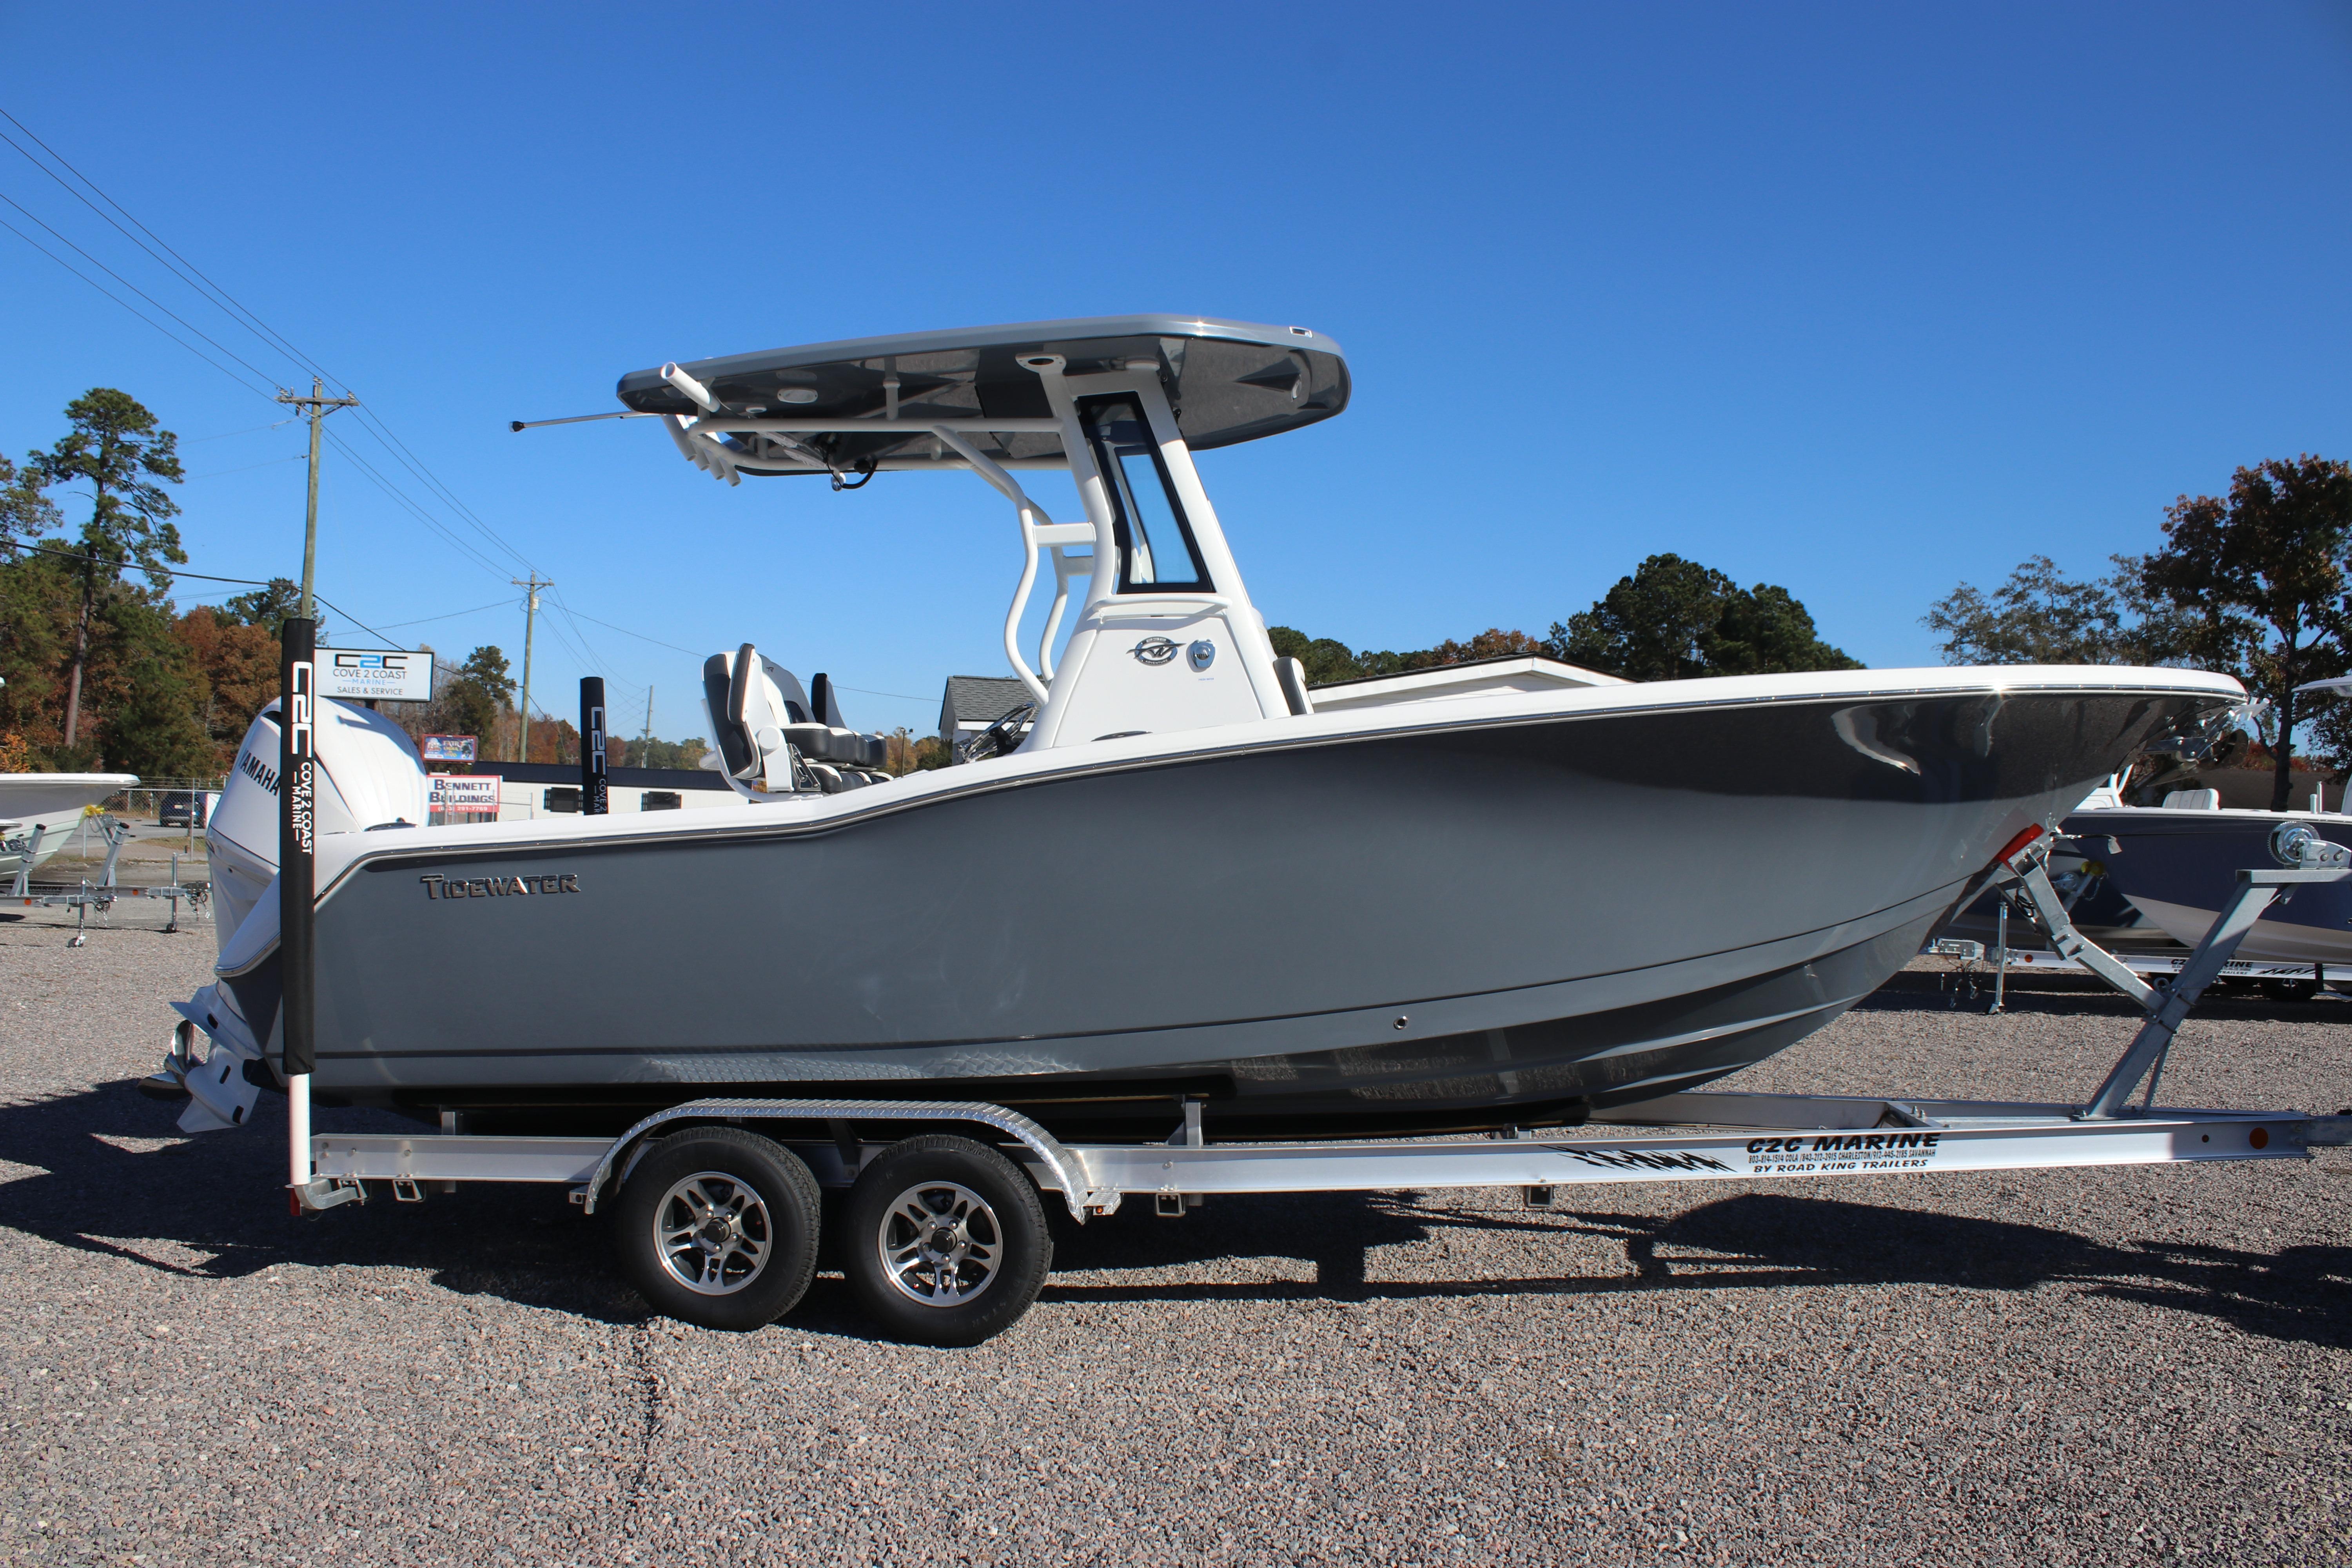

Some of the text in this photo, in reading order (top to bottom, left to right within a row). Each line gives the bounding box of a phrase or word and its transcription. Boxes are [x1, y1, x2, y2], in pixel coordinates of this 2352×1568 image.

[335, 653, 408, 670] C2C
[333, 668, 361, 677] COVE
[372, 670, 407, 679] COAST
[292, 661, 313, 758] C2C
[591, 706, 606, 775] C2C
[301, 762, 312, 797] COVE
[434, 779, 491, 790] BENNETT
[292, 786, 302, 829] MARINE
[301, 811, 312, 855] COAST
[420, 873, 581, 899] TIDEWATER
[1747, 1133, 1940, 1153] C2C MARINE
[1785, 1154, 1798, 1162] COLA
[1908, 1149, 1936, 1157] SAVANNAH
[1821, 1162, 1856, 1170] KING
[1862, 1159, 1928, 1169] TRAILERS
